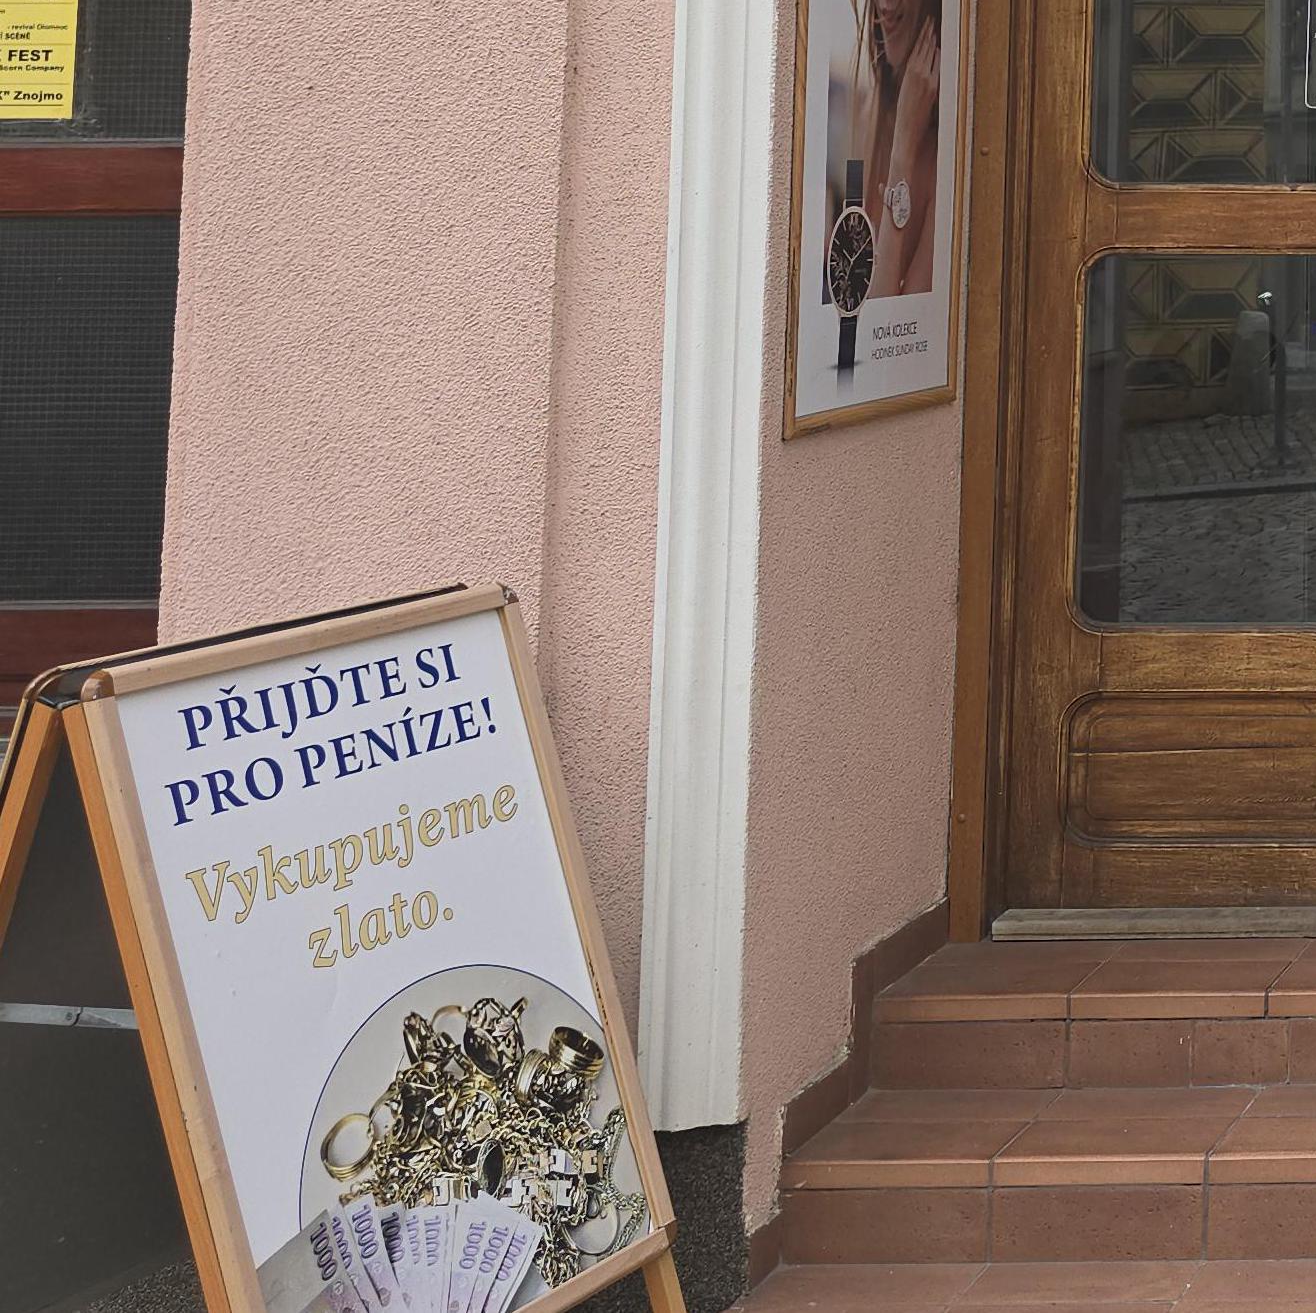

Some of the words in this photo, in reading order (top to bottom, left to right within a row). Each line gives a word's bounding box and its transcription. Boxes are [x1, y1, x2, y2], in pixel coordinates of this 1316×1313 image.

[8, 49, 53, 61] FEST
[13, 90, 63, 102] Znojmo
[178, 655, 408, 751] PŘIJĎTE
[414, 643, 462, 689] SI
[164, 757, 286, 827] PRO
[294, 696, 498, 790] PENÍZE!
[185, 783, 519, 924] Vykupujeme
[307, 889, 454, 970] zlato.
[309, 1221, 338, 1282] 1000
[351, 1204, 379, 1260] 1000
[458, 1221, 487, 1270] 1000
